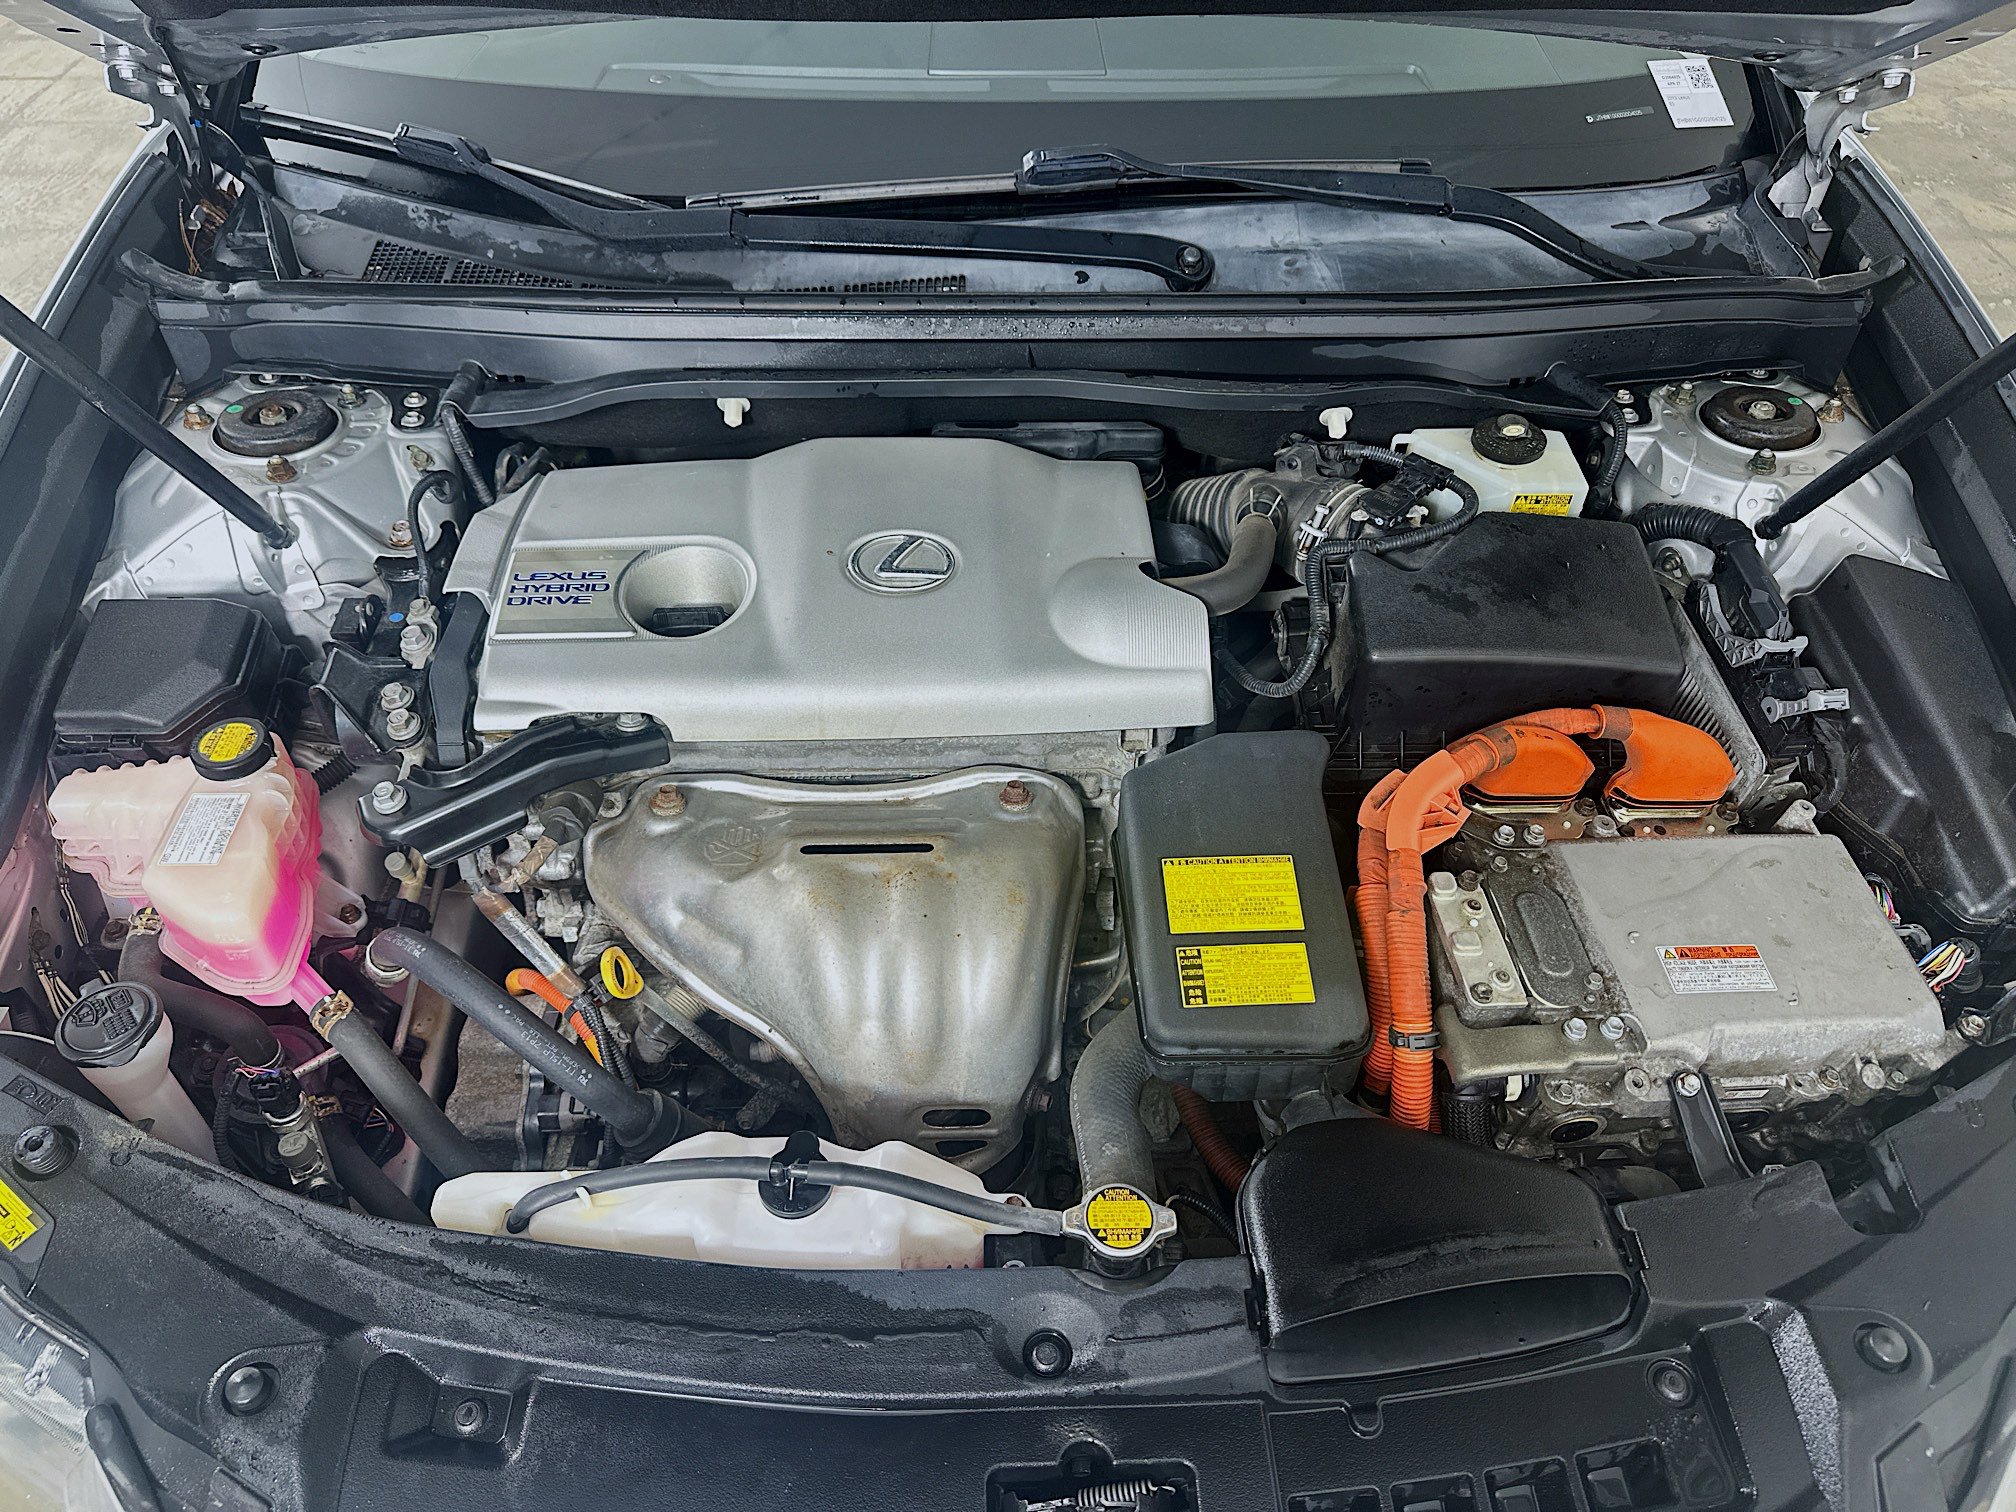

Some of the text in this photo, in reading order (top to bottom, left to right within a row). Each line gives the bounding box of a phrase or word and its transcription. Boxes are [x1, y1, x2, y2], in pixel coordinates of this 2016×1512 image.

[513, 571, 608, 582] LEXUS
[510, 582, 611, 593] HYBRID
[507, 594, 593, 605] DRIVE
[1180, 958, 1202, 966] CAUTION
[520, 1030, 542, 1050] 7P13
[543, 1049, 576, 1076] TT-15LP
